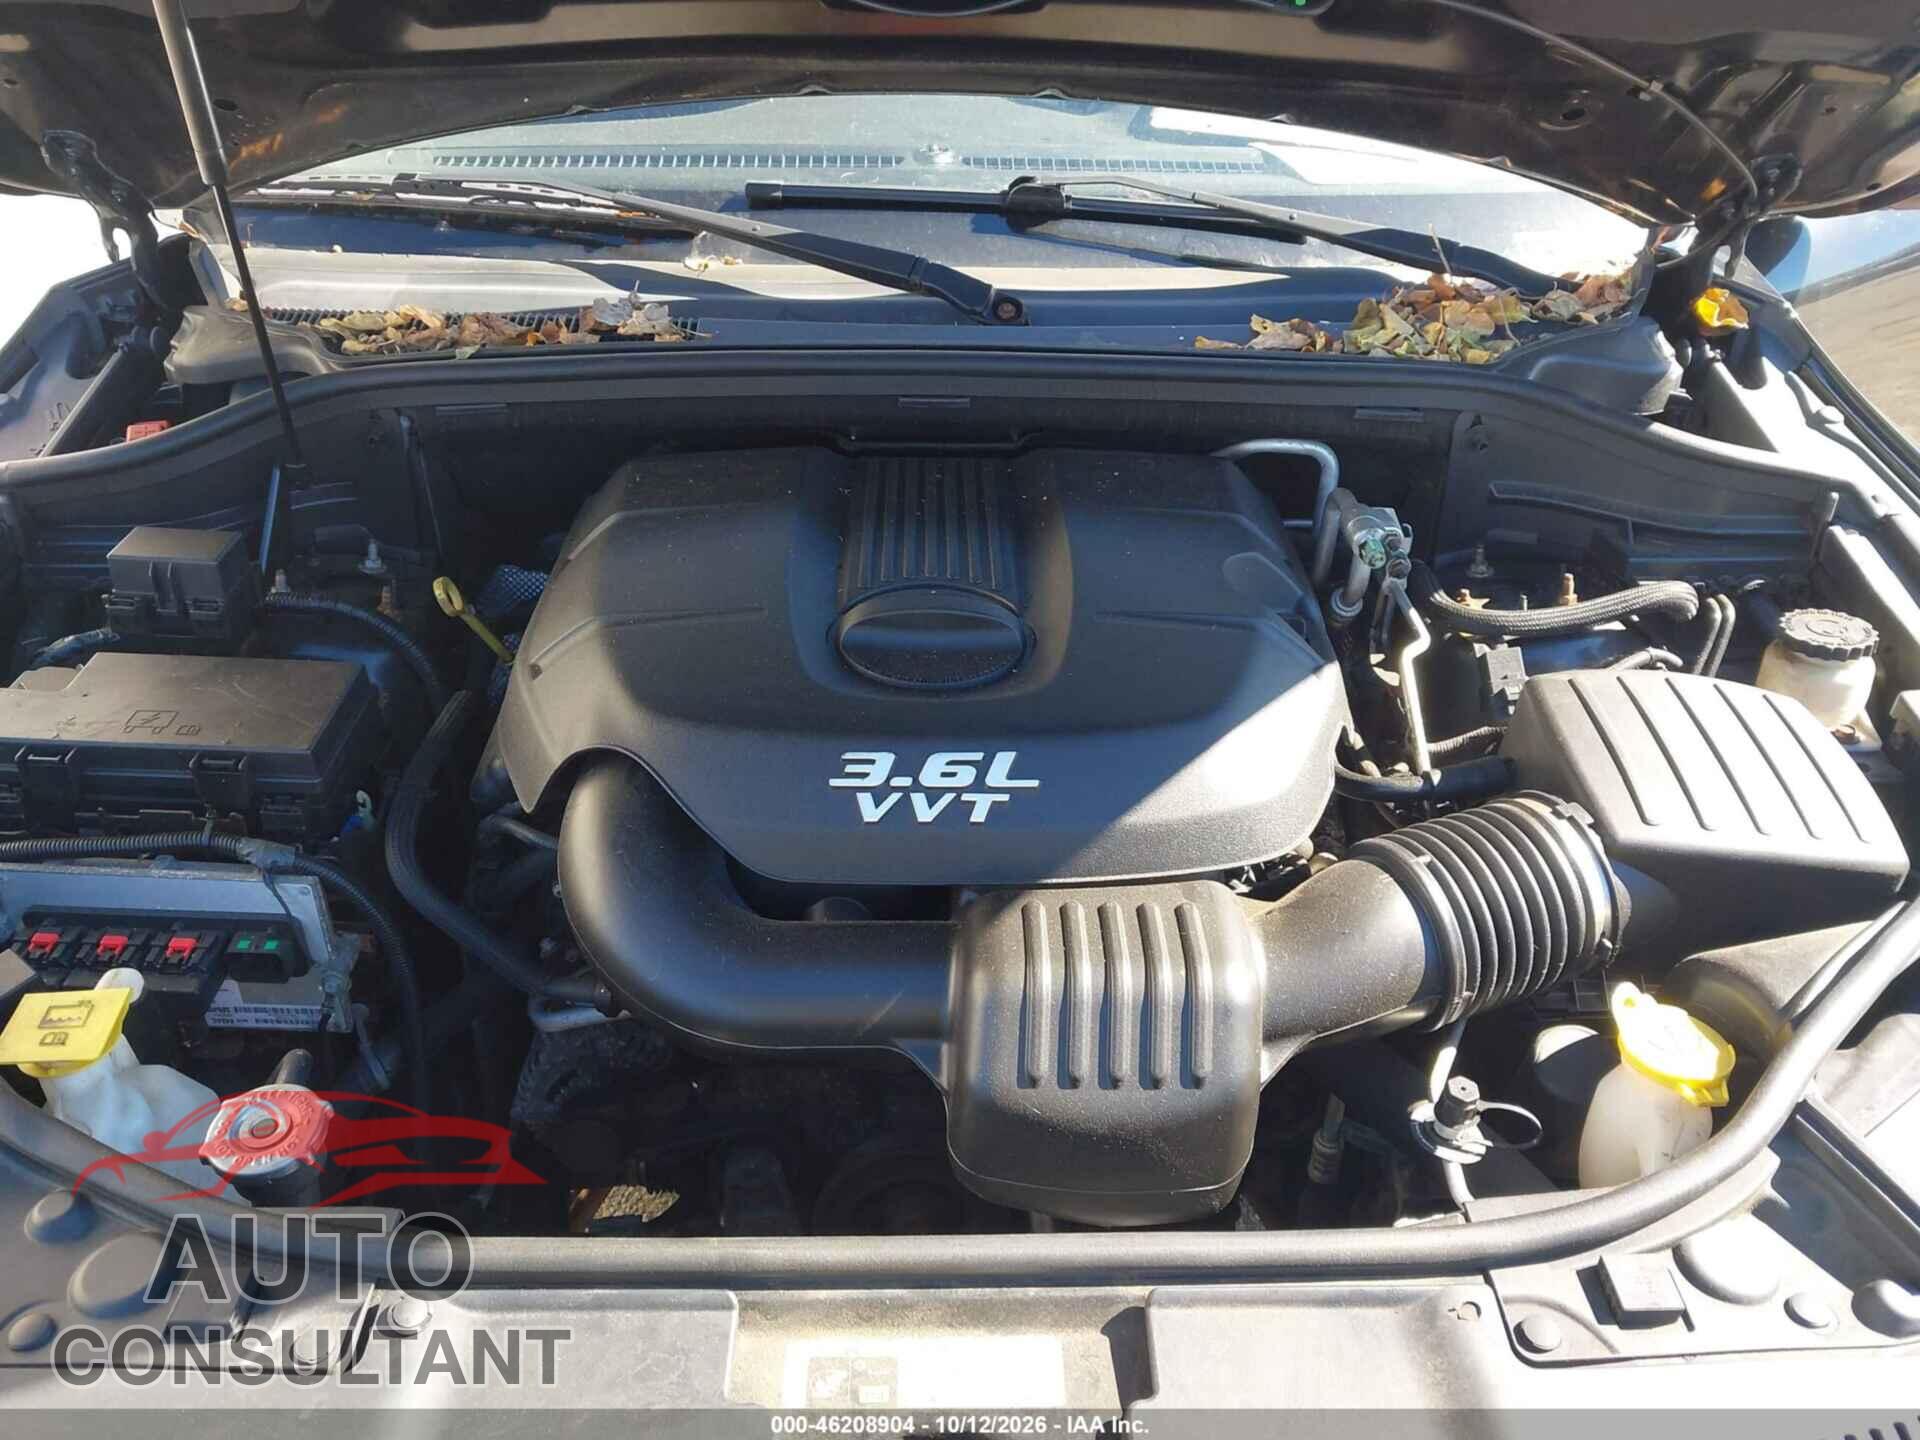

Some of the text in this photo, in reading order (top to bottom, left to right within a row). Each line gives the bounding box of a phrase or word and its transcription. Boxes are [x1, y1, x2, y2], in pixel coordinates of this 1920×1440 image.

[828, 751, 1040, 787] 3.6L
[855, 792, 1010, 822] VVT
[232, 1153, 273, 1168] OPEN
